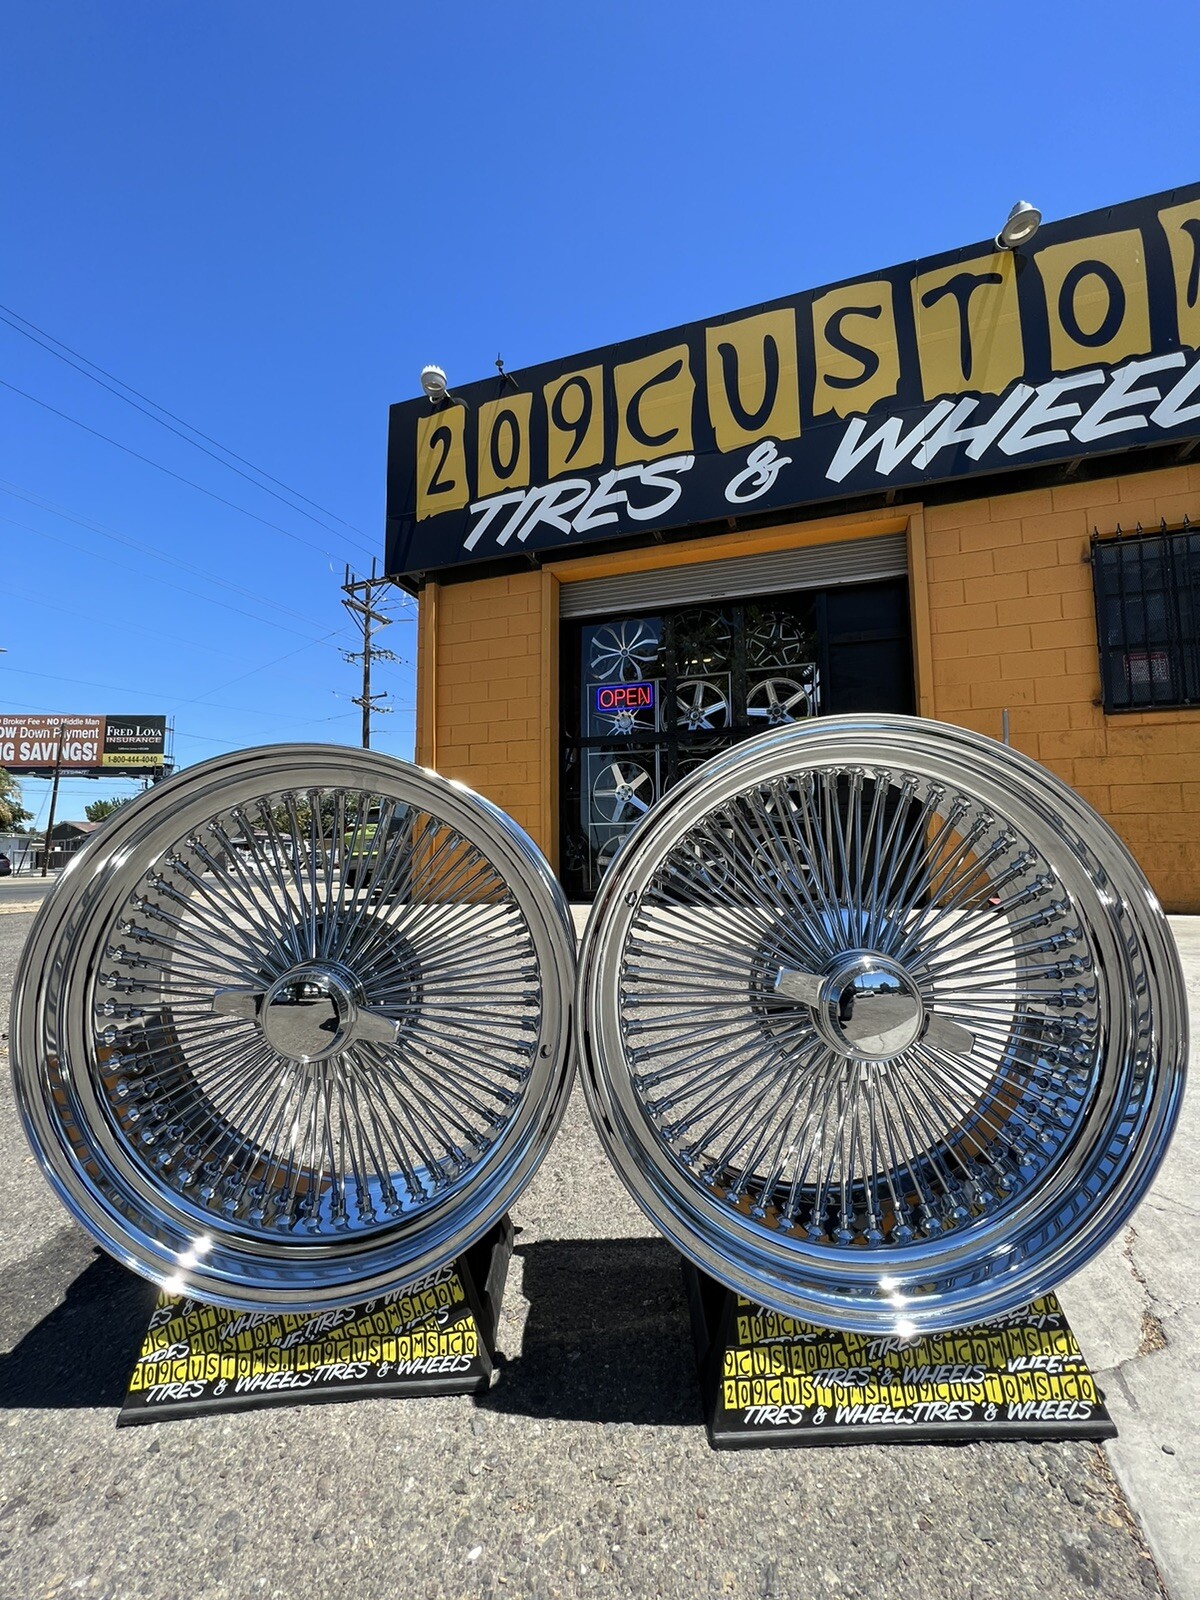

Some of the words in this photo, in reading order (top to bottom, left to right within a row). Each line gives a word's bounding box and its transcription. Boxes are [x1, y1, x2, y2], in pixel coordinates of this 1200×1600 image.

[463, 454, 695, 552] TIRES
[724, 440, 792, 504] &
[600, 687, 650, 707] OPEN
[61, 718, 84, 726] Middle
[85, 718, 100, 726] Man
[20, 727, 50, 739] Down
[53, 727, 99, 741] Pyment
[20, 742, 98, 761] SAVINGS!
[146, 1379, 208, 1402] TIRES
[213, 1378, 228, 1396] &
[313, 1361, 371, 1382] TIRES
[377, 1361, 391, 1378] &
[397, 1354, 473, 1376] WHEELS
[813, 1367, 871, 1388] TIRES
[902, 1364, 987, 1385] WHEELS
[744, 1404, 805, 1425] TIRES
[813, 1406, 828, 1425] &
[912, 1401, 975, 1422] TIRES
[984, 1402, 999, 1422] &
[1007, 1400, 1094, 1421] WHEELS
